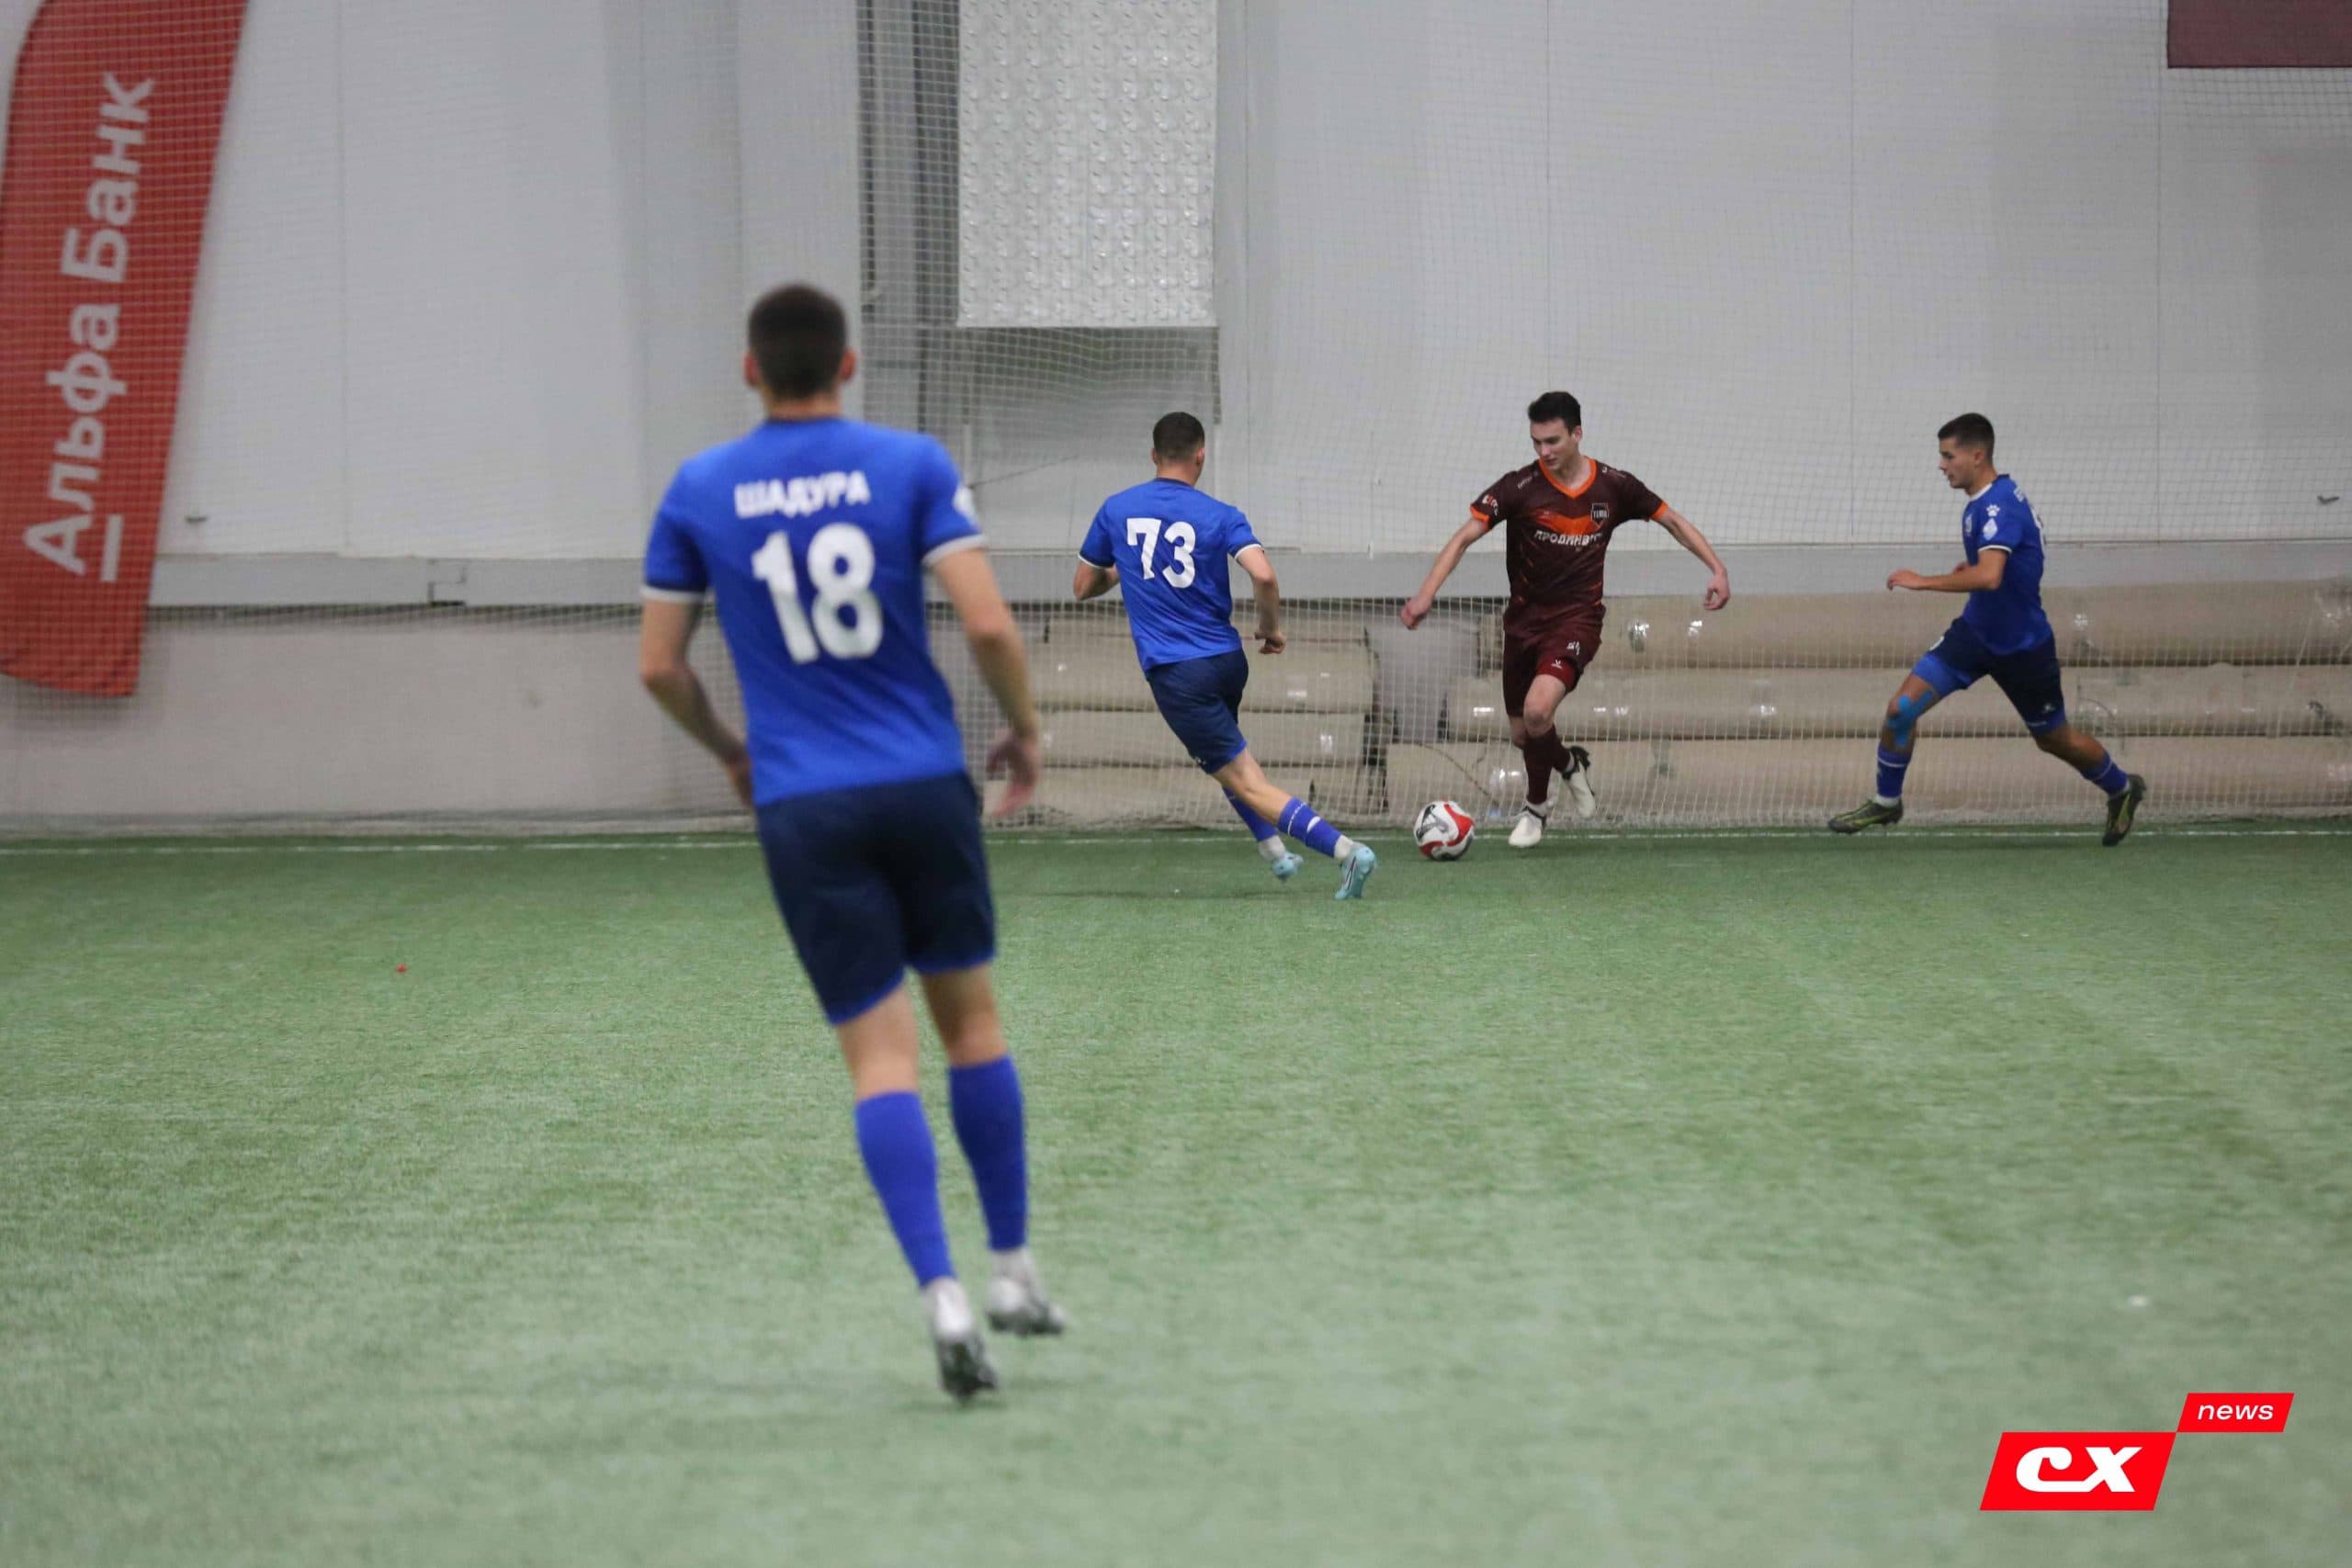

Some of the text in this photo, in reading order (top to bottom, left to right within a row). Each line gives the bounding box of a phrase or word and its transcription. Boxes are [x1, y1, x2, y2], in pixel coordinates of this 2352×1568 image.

[23, 72, 154, 576] Альфа Банк
[735, 470, 870, 519] ШАДУРА
[751, 522, 883, 664] 18
[1126, 517, 1196, 589] 73
